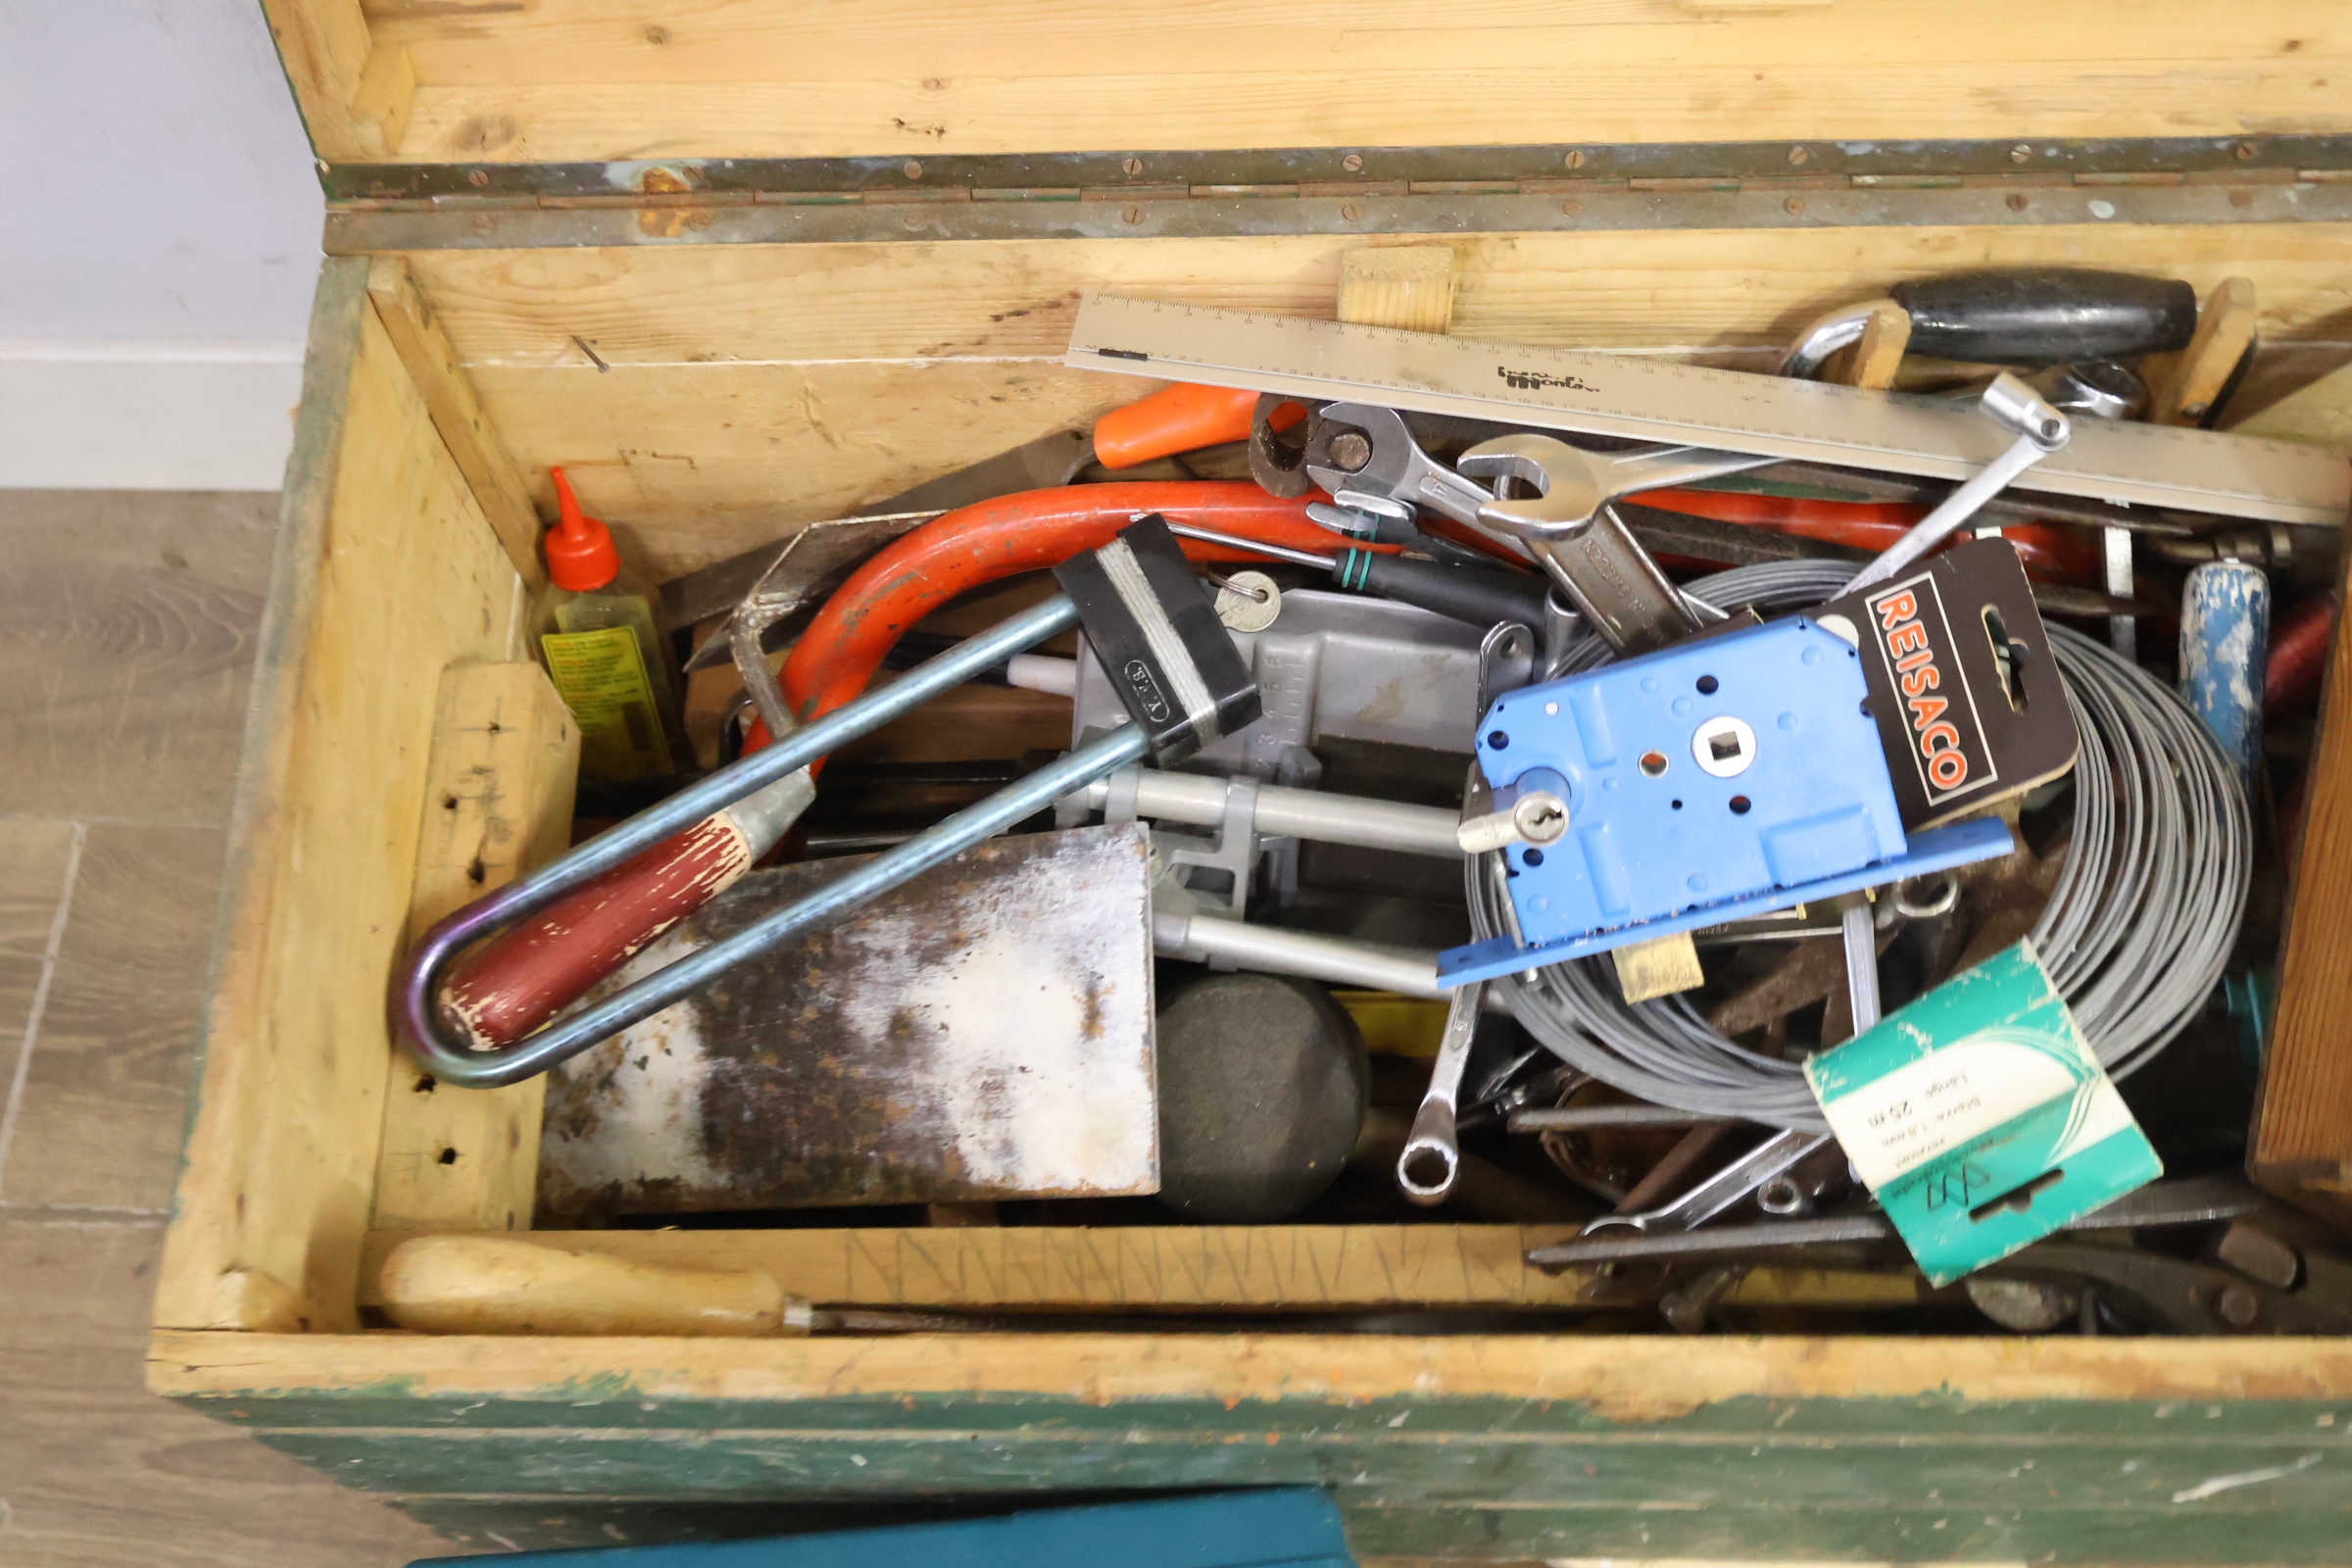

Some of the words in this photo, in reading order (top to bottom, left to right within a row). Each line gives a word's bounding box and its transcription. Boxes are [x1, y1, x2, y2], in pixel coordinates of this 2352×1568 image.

[1876, 588, 1968, 791] REISACO
[1868, 1111, 1886, 1129] m
[1889, 1099, 1913, 1121] 25
